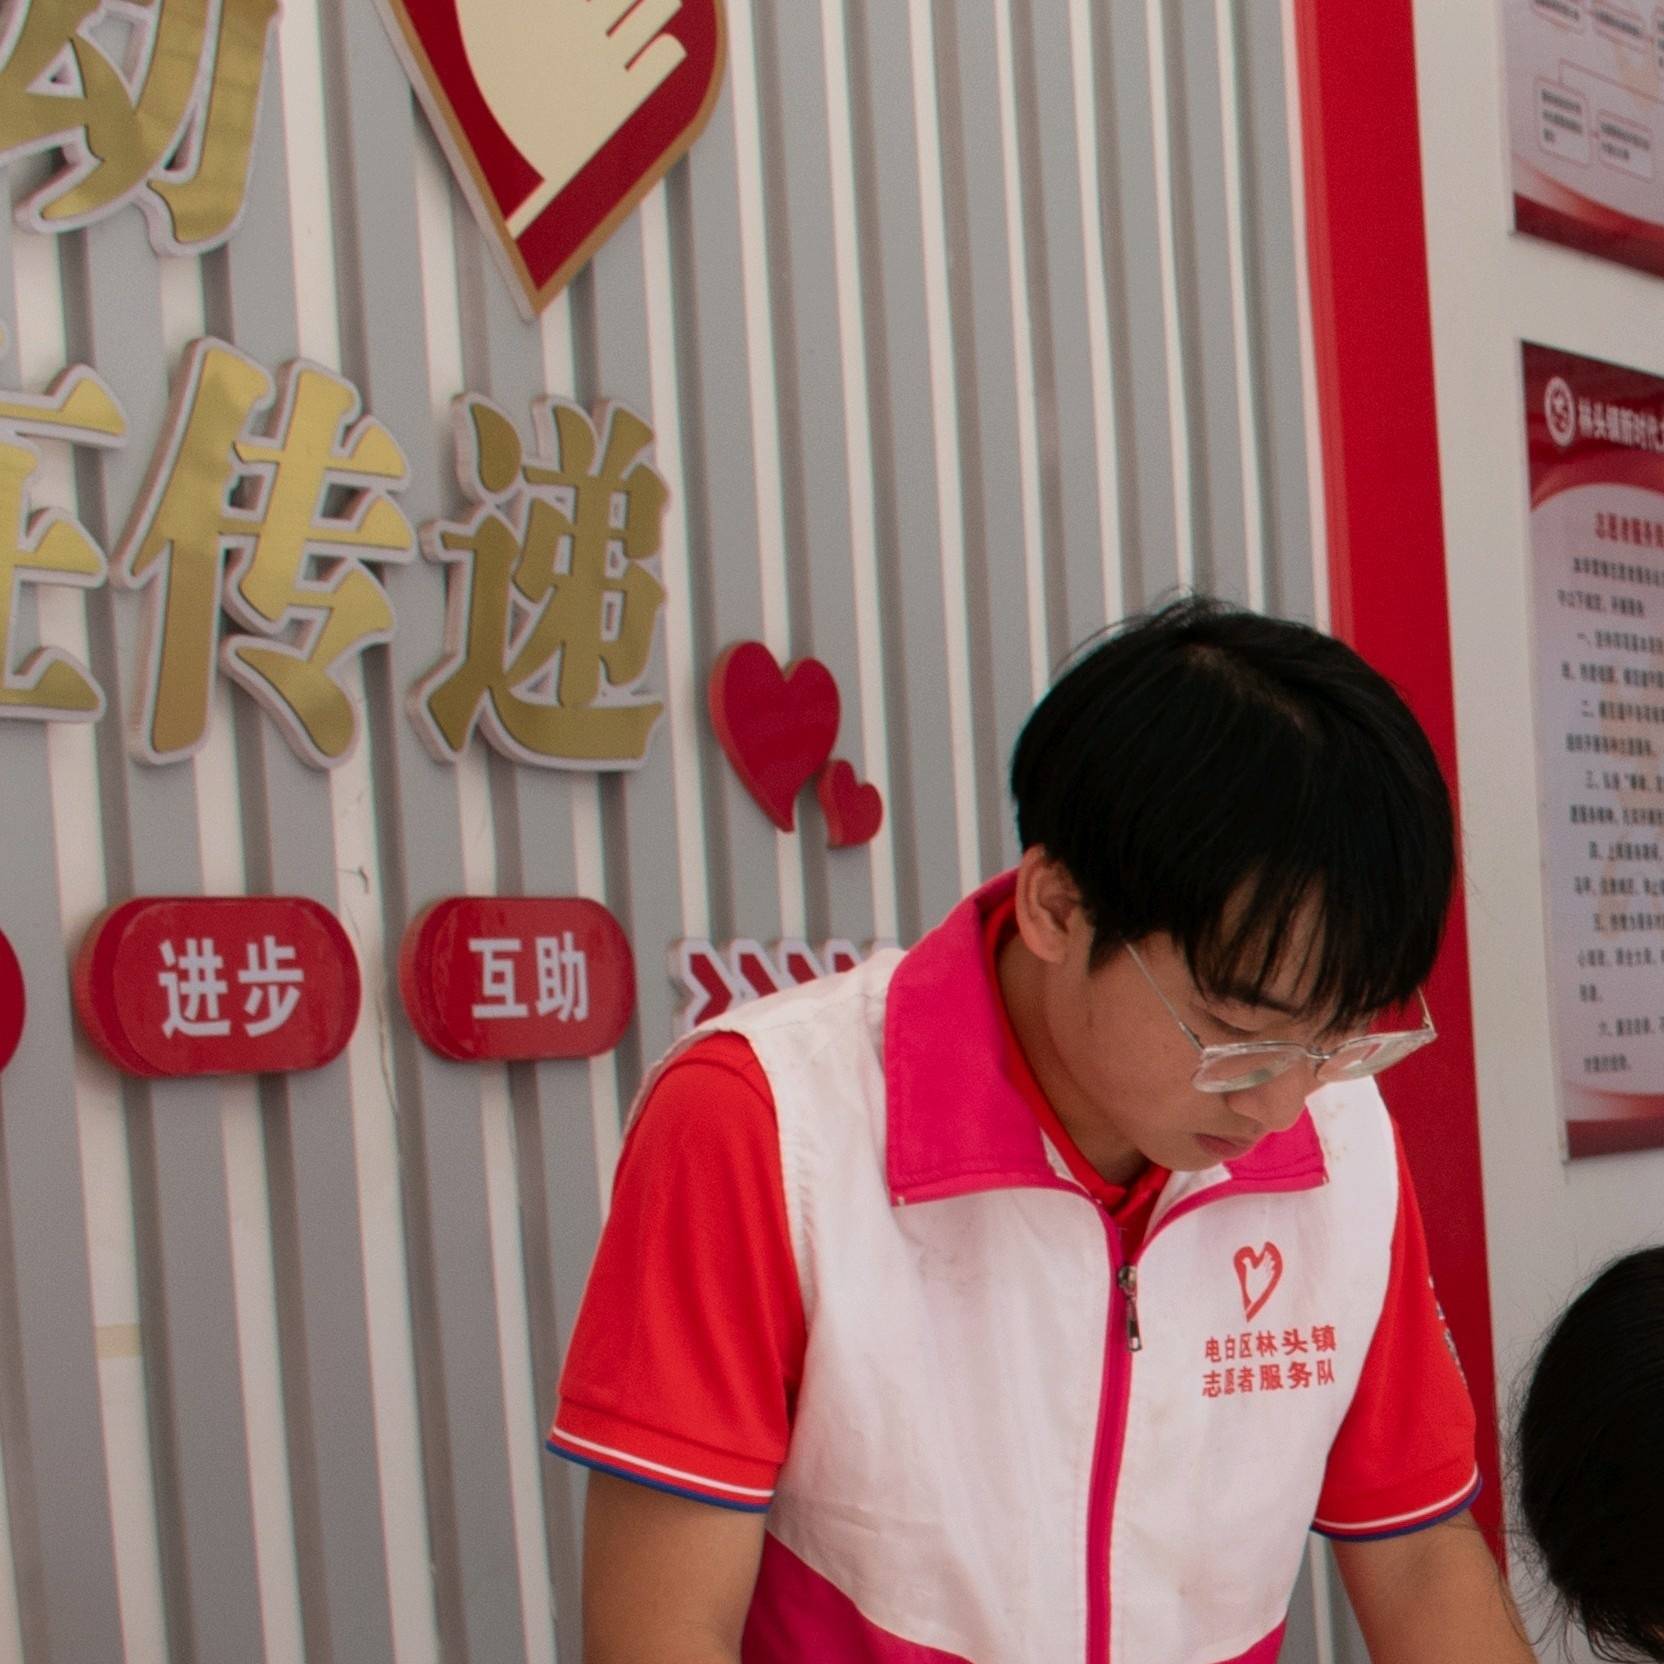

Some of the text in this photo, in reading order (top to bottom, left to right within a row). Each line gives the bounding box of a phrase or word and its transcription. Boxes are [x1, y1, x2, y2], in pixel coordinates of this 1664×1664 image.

[158, 935, 304, 1039] 进步
[469, 931, 590, 1022] 互助
[1204, 1325, 1337, 1363] 电白区林头镇
[1203, 1359, 1335, 1398] 志愿者服务队
